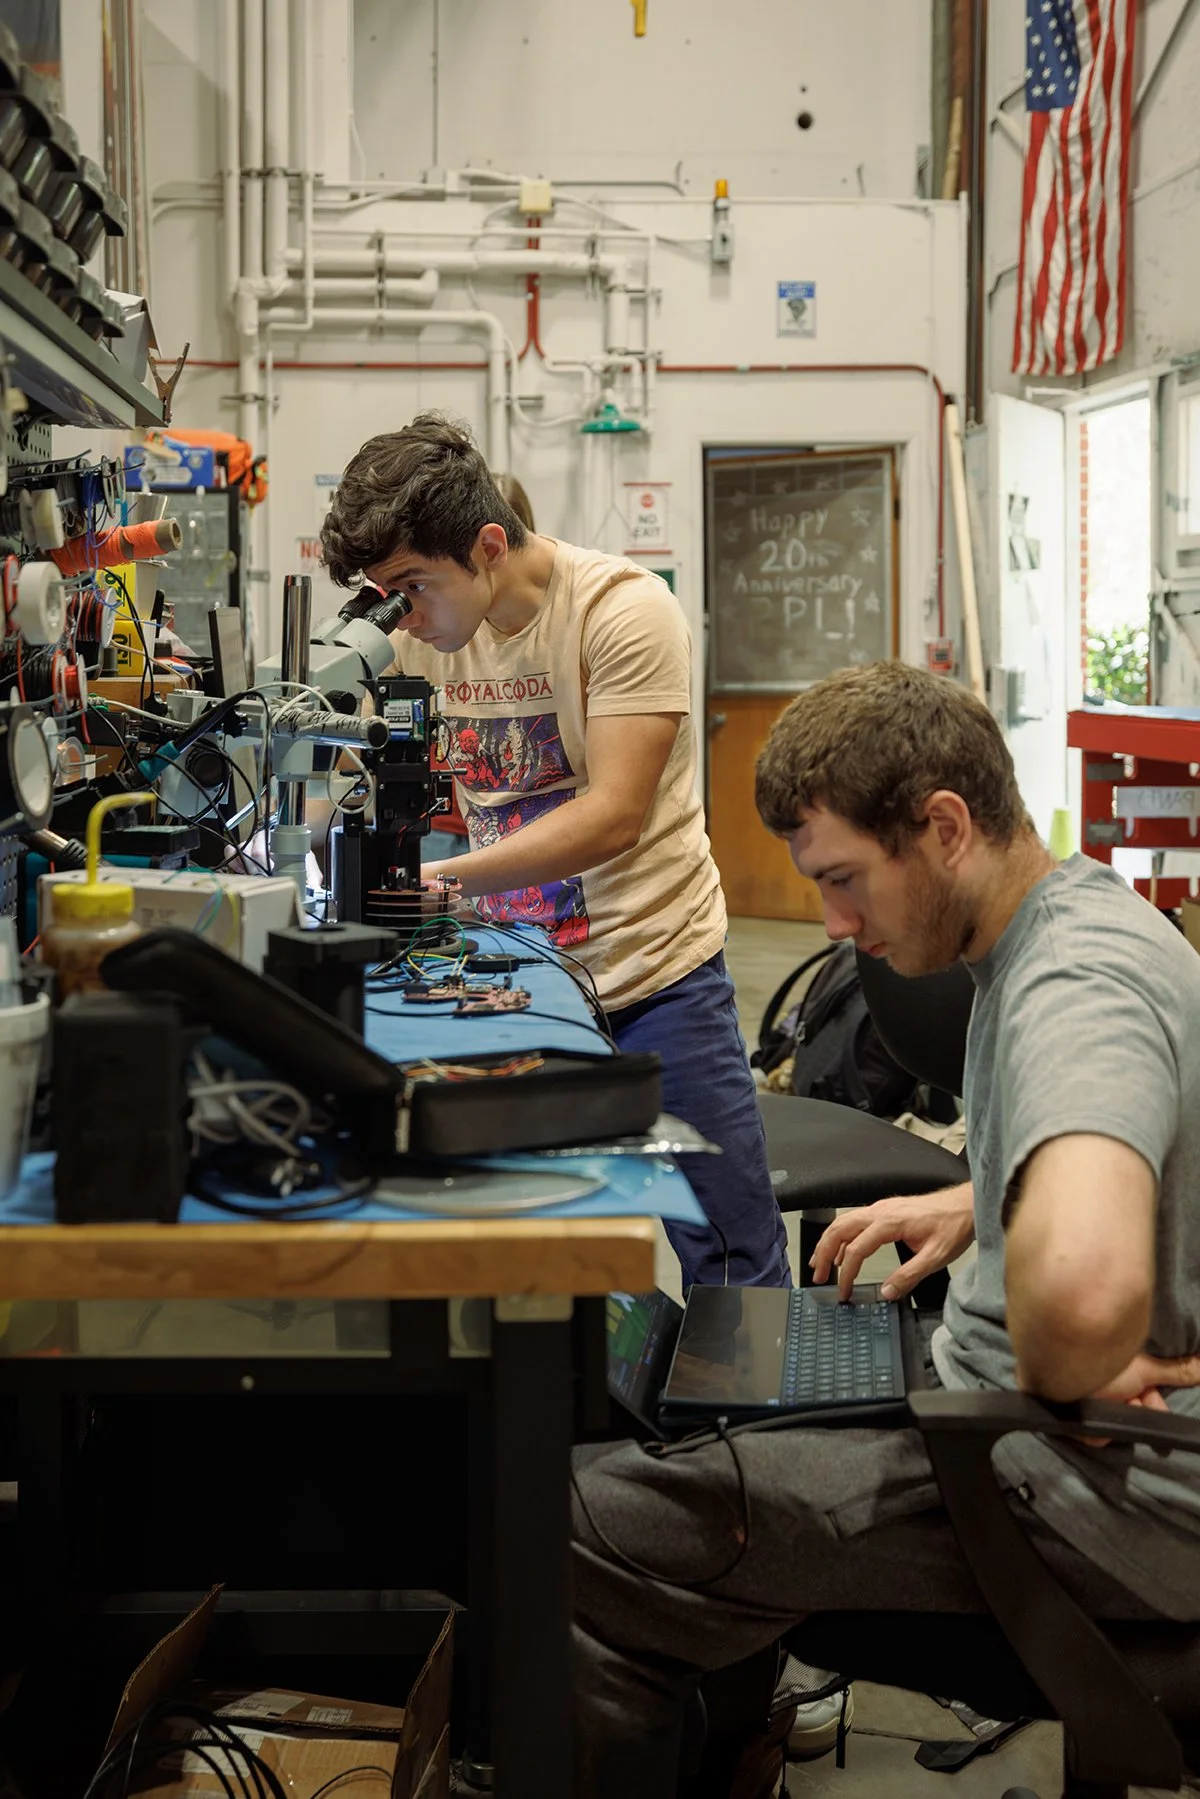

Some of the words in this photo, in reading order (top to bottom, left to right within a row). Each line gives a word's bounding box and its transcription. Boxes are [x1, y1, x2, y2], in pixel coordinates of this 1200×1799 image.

[638, 514, 658, 525] NO
[751, 508, 829, 540] Happy
[633, 527, 660, 539] EXIT
[733, 572, 863, 600] Anniversary
